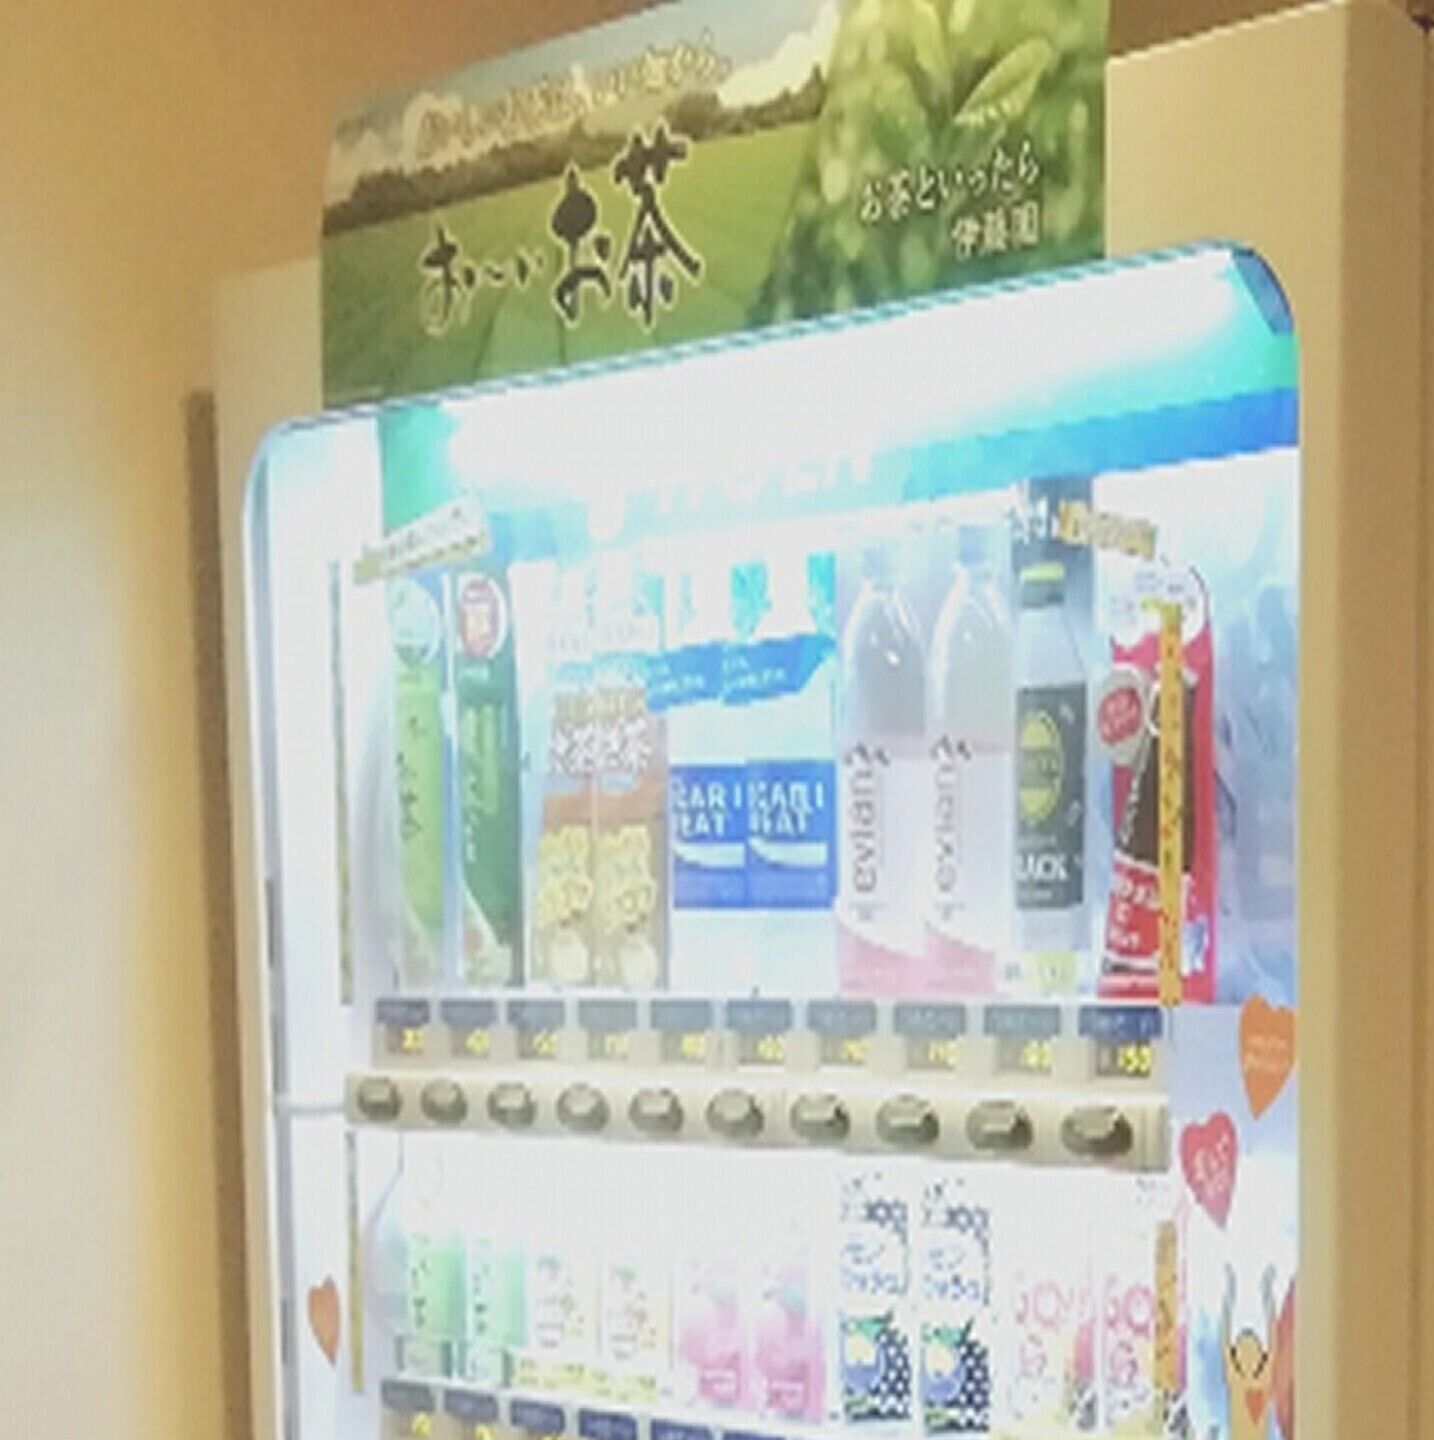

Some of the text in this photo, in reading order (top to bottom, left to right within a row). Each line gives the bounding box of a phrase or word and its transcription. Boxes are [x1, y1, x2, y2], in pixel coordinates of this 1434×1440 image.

[859, 139, 1040, 223] お茶といったら
